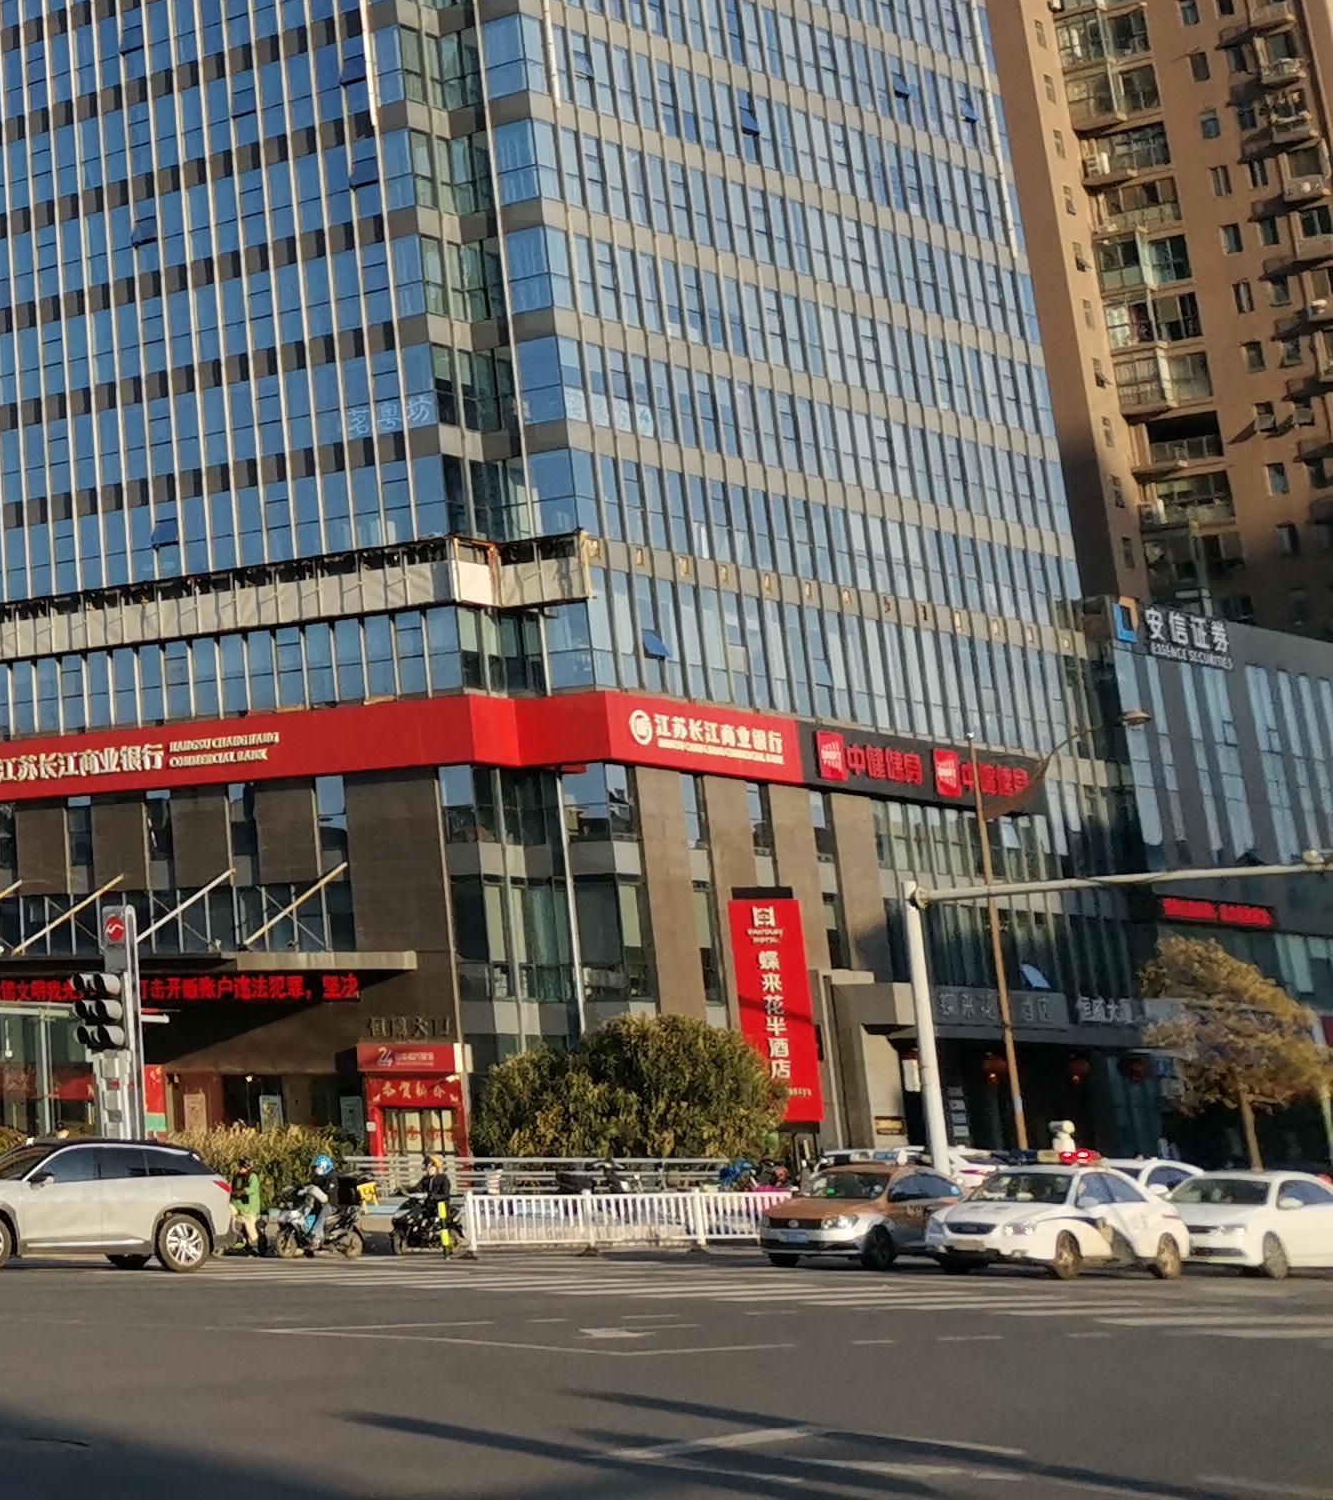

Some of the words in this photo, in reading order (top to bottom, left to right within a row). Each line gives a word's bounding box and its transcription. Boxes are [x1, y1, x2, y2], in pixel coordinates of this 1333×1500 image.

[1145, 607, 1229, 653] 安信证券
[653, 713, 783, 754] 江苏长江商业银行
[757, 950, 792, 1080] 蝶来花半酒店
